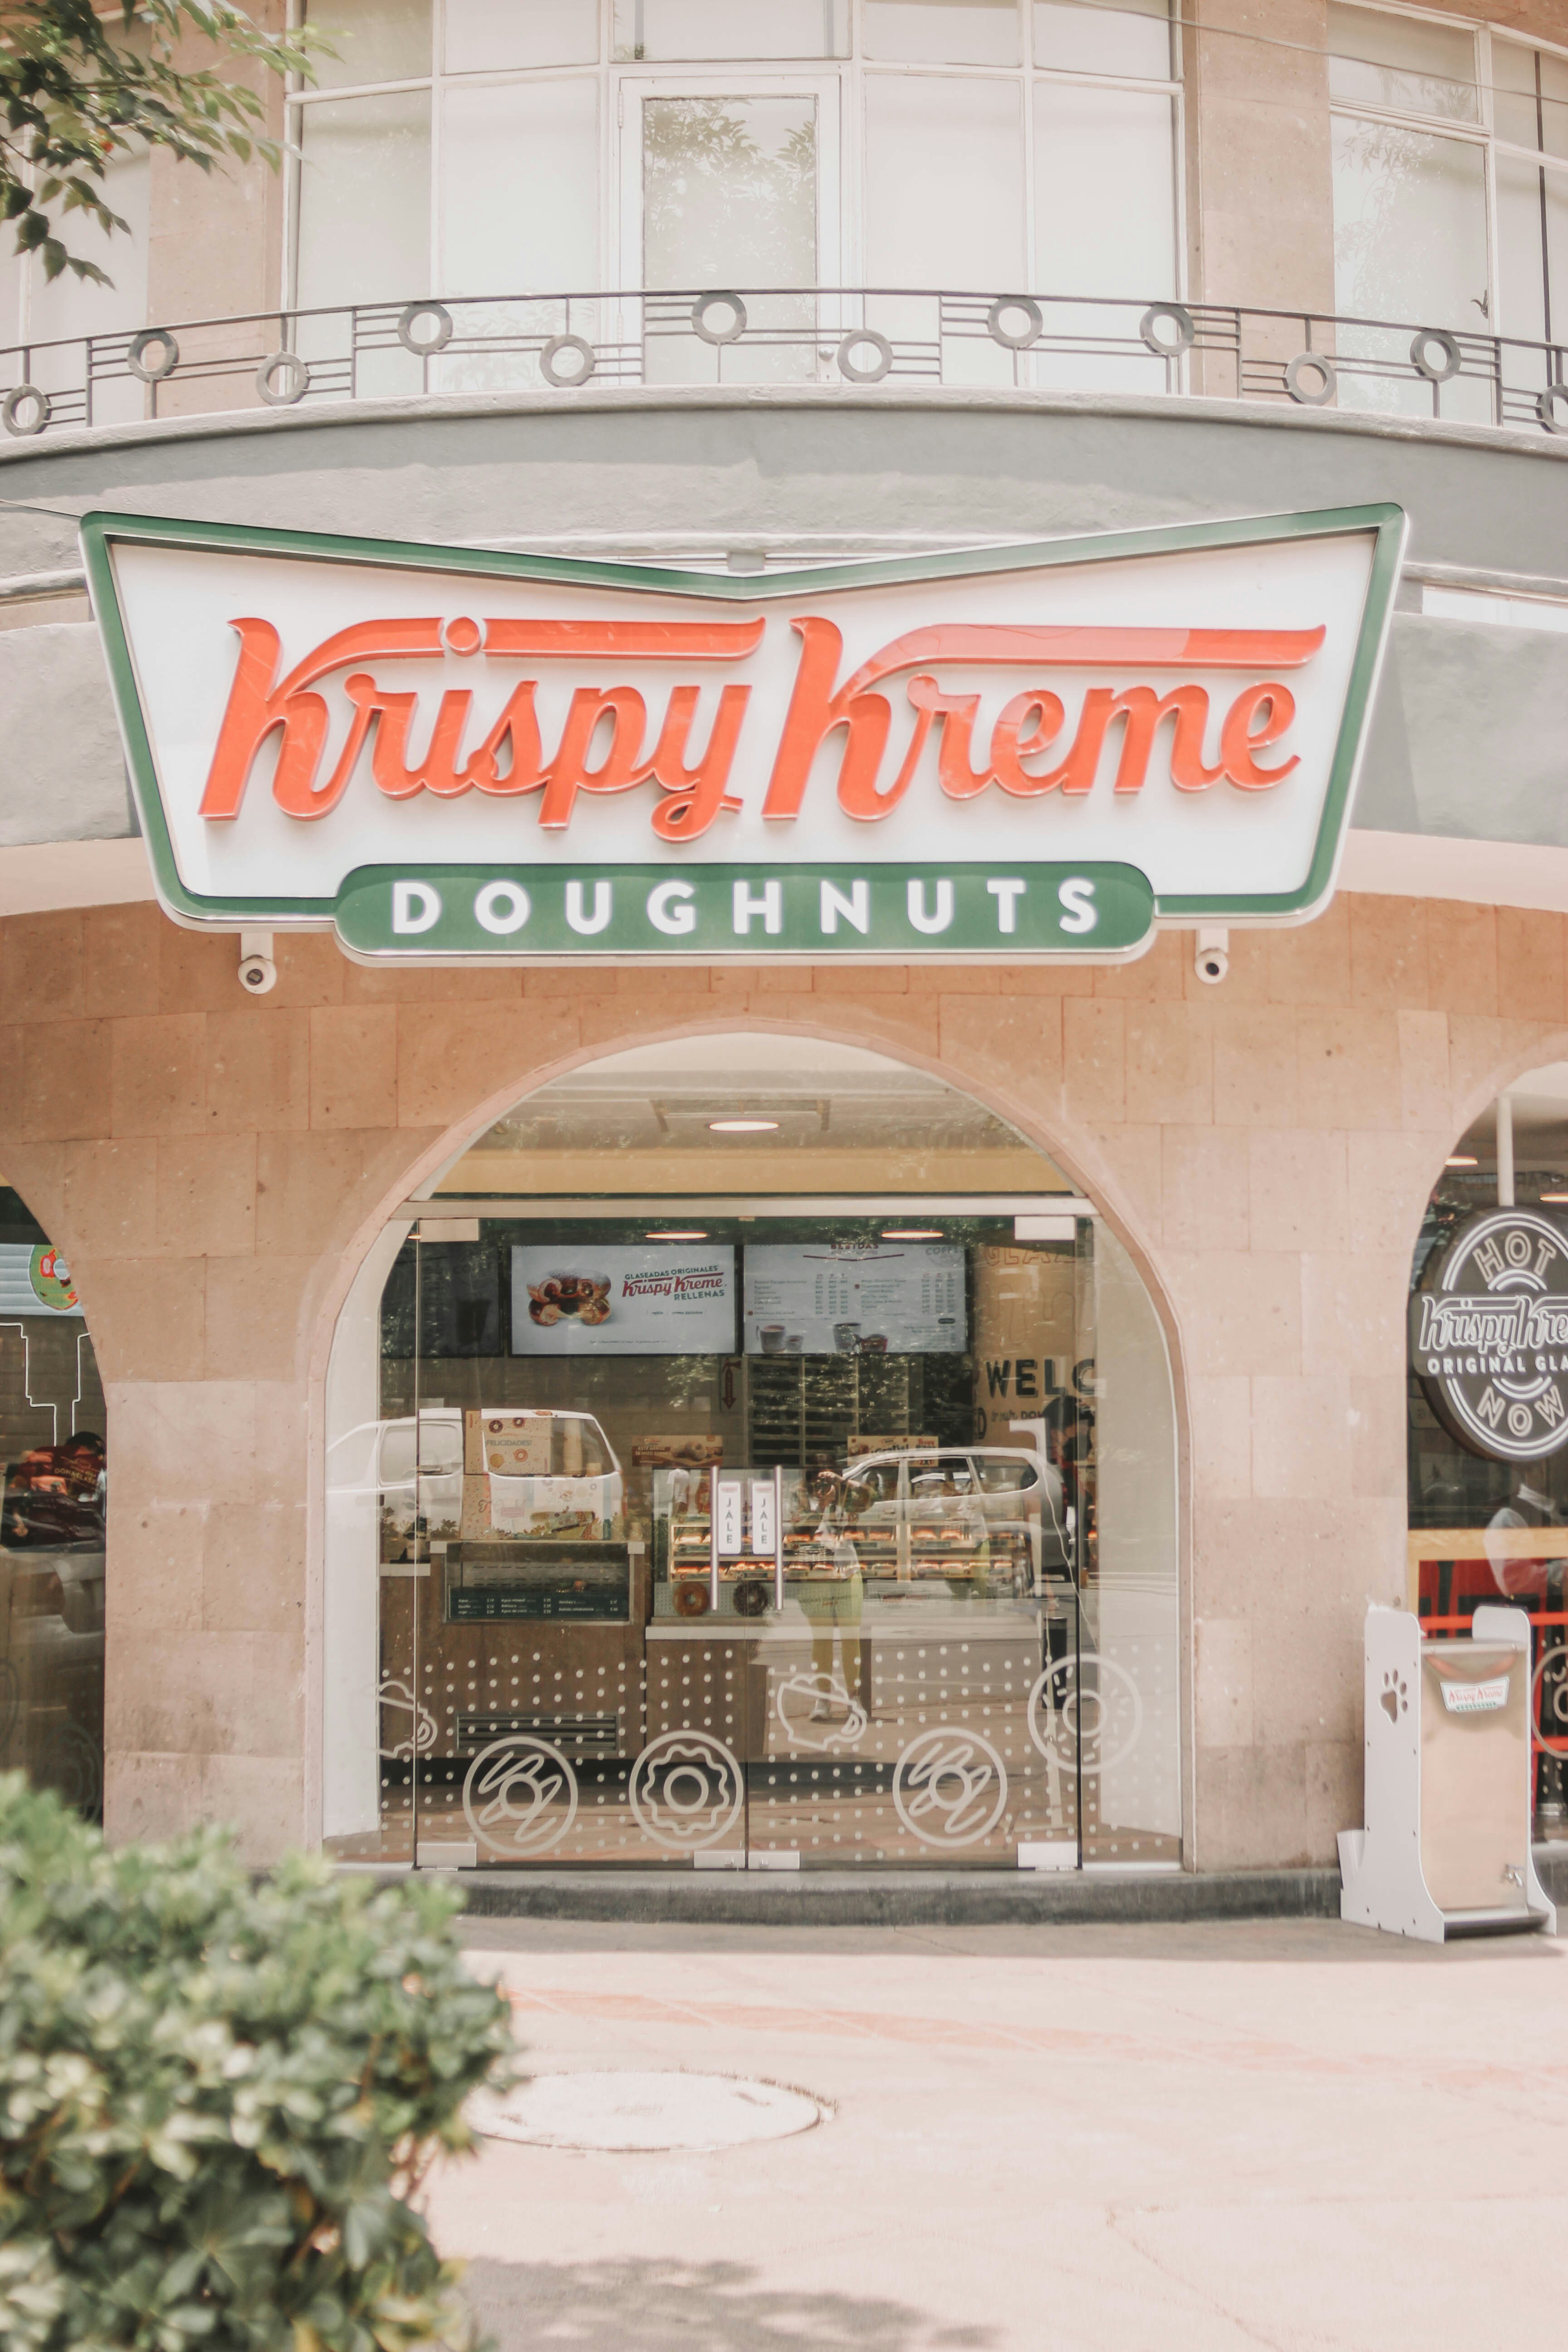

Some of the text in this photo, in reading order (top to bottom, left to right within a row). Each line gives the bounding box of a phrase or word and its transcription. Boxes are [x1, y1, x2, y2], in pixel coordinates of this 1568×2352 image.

[198, 617, 1326, 843] Krispy Kreme
[392, 878, 1098, 936] DOUGHNUTS
[625, 1265, 719, 1280] GLASEADAS ORIGINALES
[1473, 1230, 1557, 1283] HOT
[622, 1272, 725, 1298] Krispy Kreme
[674, 1289, 725, 1301] RELLENAS
[1419, 1296, 1519, 1357] Krispy
[1427, 1355, 1526, 1374] ORIGINAL
[1476, 1385, 1565, 1437] NOW
[725, 1498, 733, 1544] JALE
